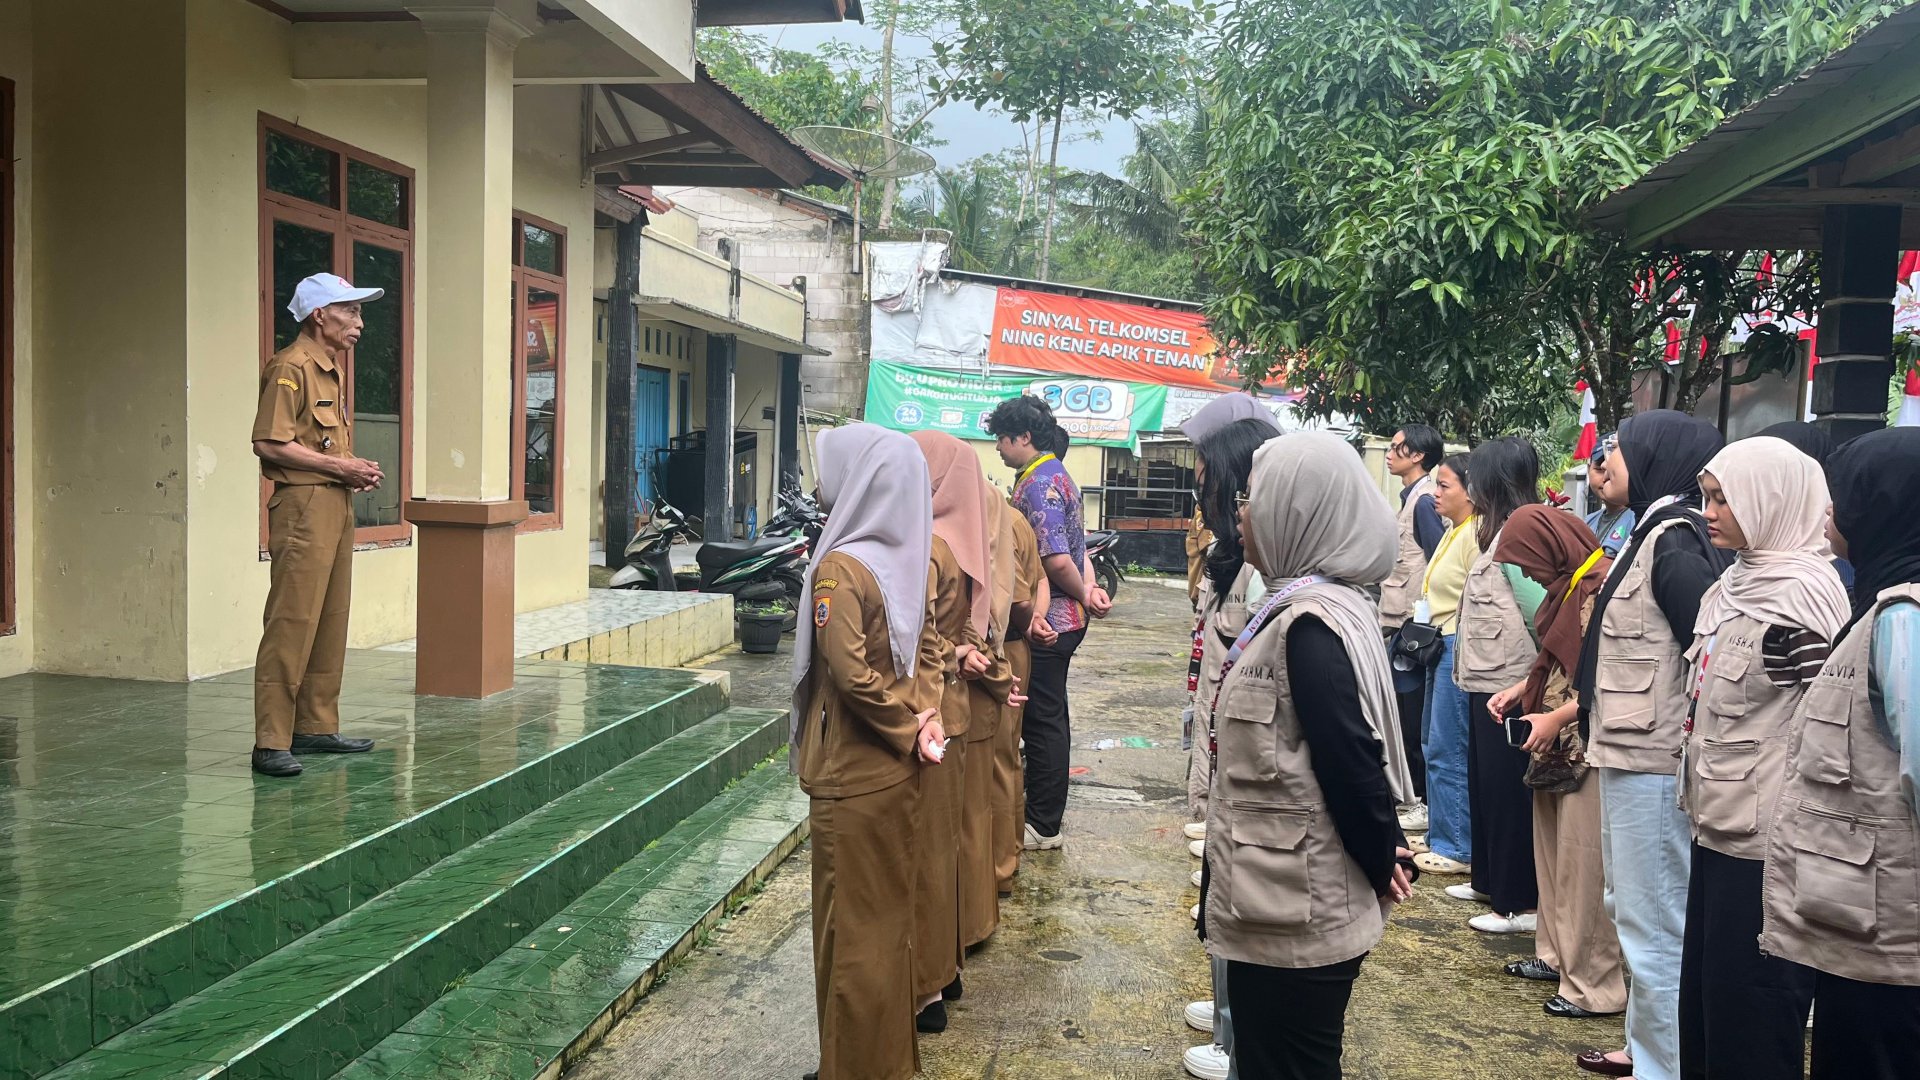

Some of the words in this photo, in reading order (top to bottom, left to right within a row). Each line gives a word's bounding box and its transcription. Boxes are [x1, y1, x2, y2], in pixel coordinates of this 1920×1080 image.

[1021, 309, 1084, 333] SINYAL
[1087, 318, 1190, 347] TELKOMSEL
[1001, 328, 1045, 349] NING
[1048, 336, 1096, 355] KENE
[1099, 342, 1141, 361] APIK
[1143, 347, 1206, 371] TENAN
[1823, 665, 1855, 680] SILVIA
